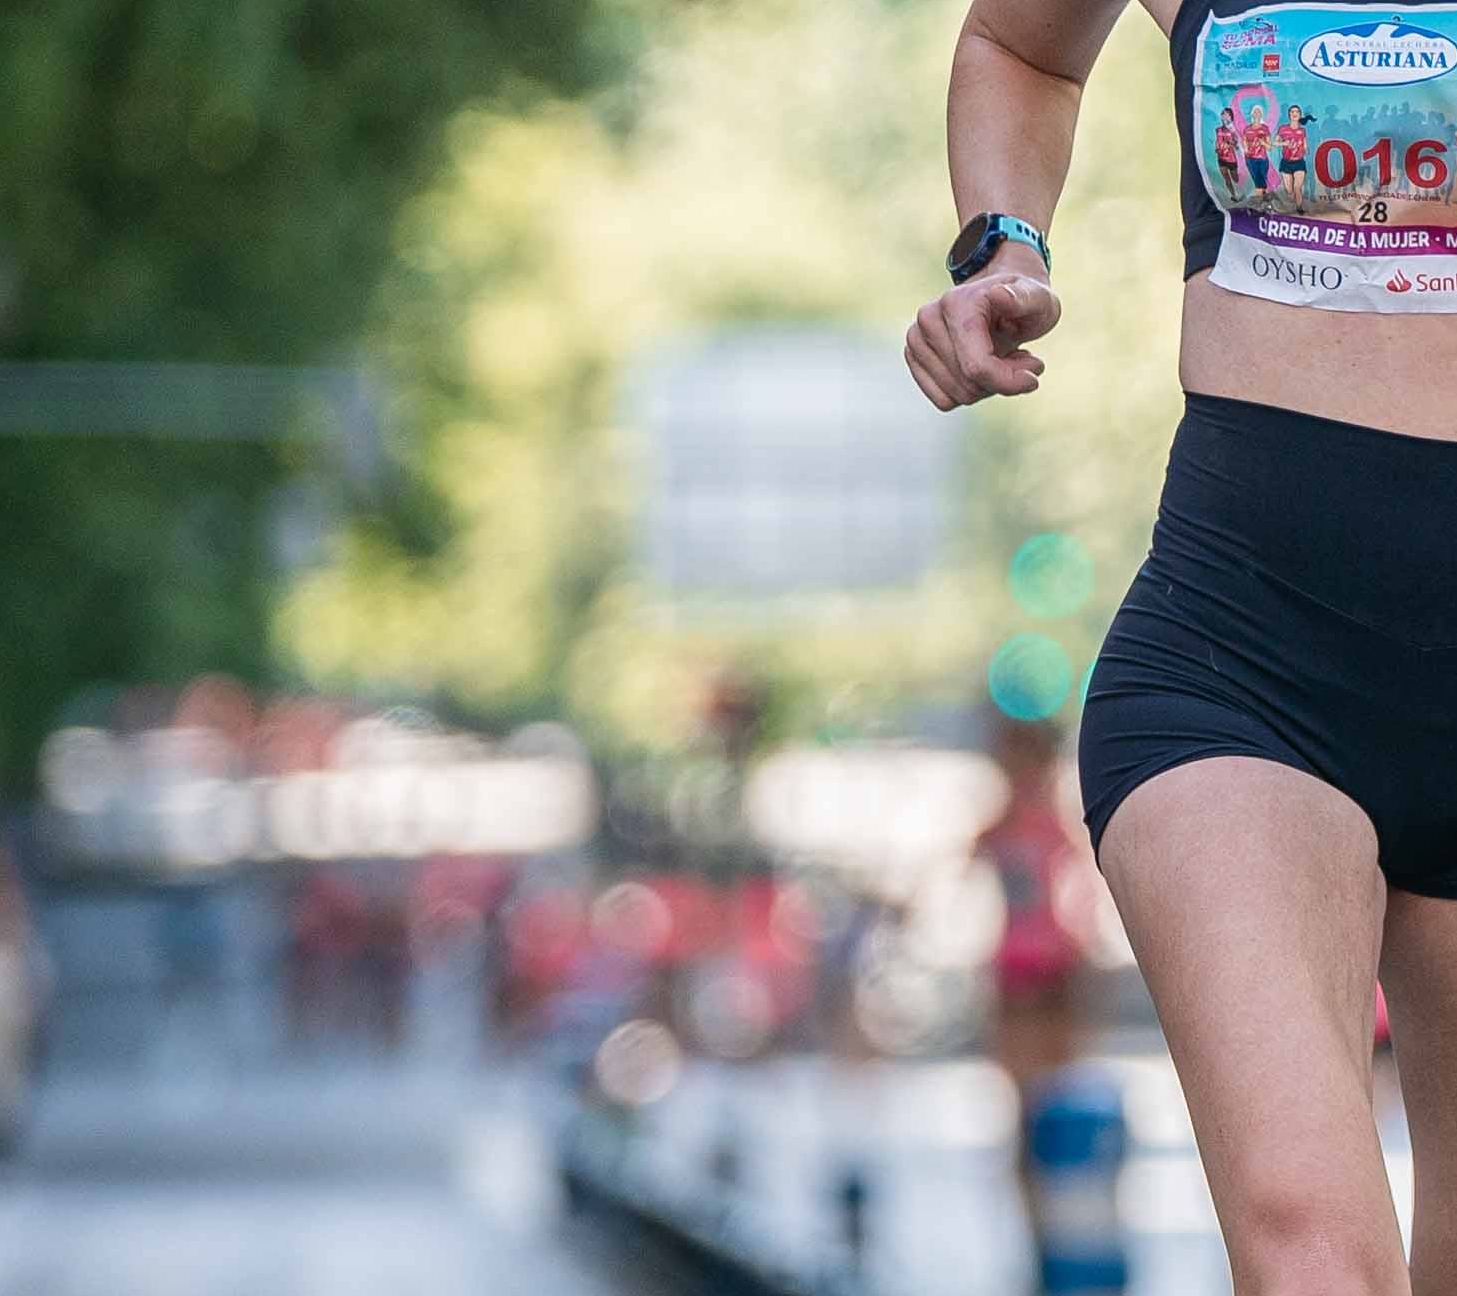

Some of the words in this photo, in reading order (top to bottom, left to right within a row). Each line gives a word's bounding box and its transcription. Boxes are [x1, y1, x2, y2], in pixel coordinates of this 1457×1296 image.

[1310, 41, 1448, 69] ASTURIANA
[1315, 138, 1448, 189] 016
[1358, 201, 1388, 222] 28
[1324, 228, 1346, 247] DE
[1349, 231, 1367, 249] LA
[1371, 231, 1430, 249] MUJER
[1252, 254, 1342, 290] OYSHO
